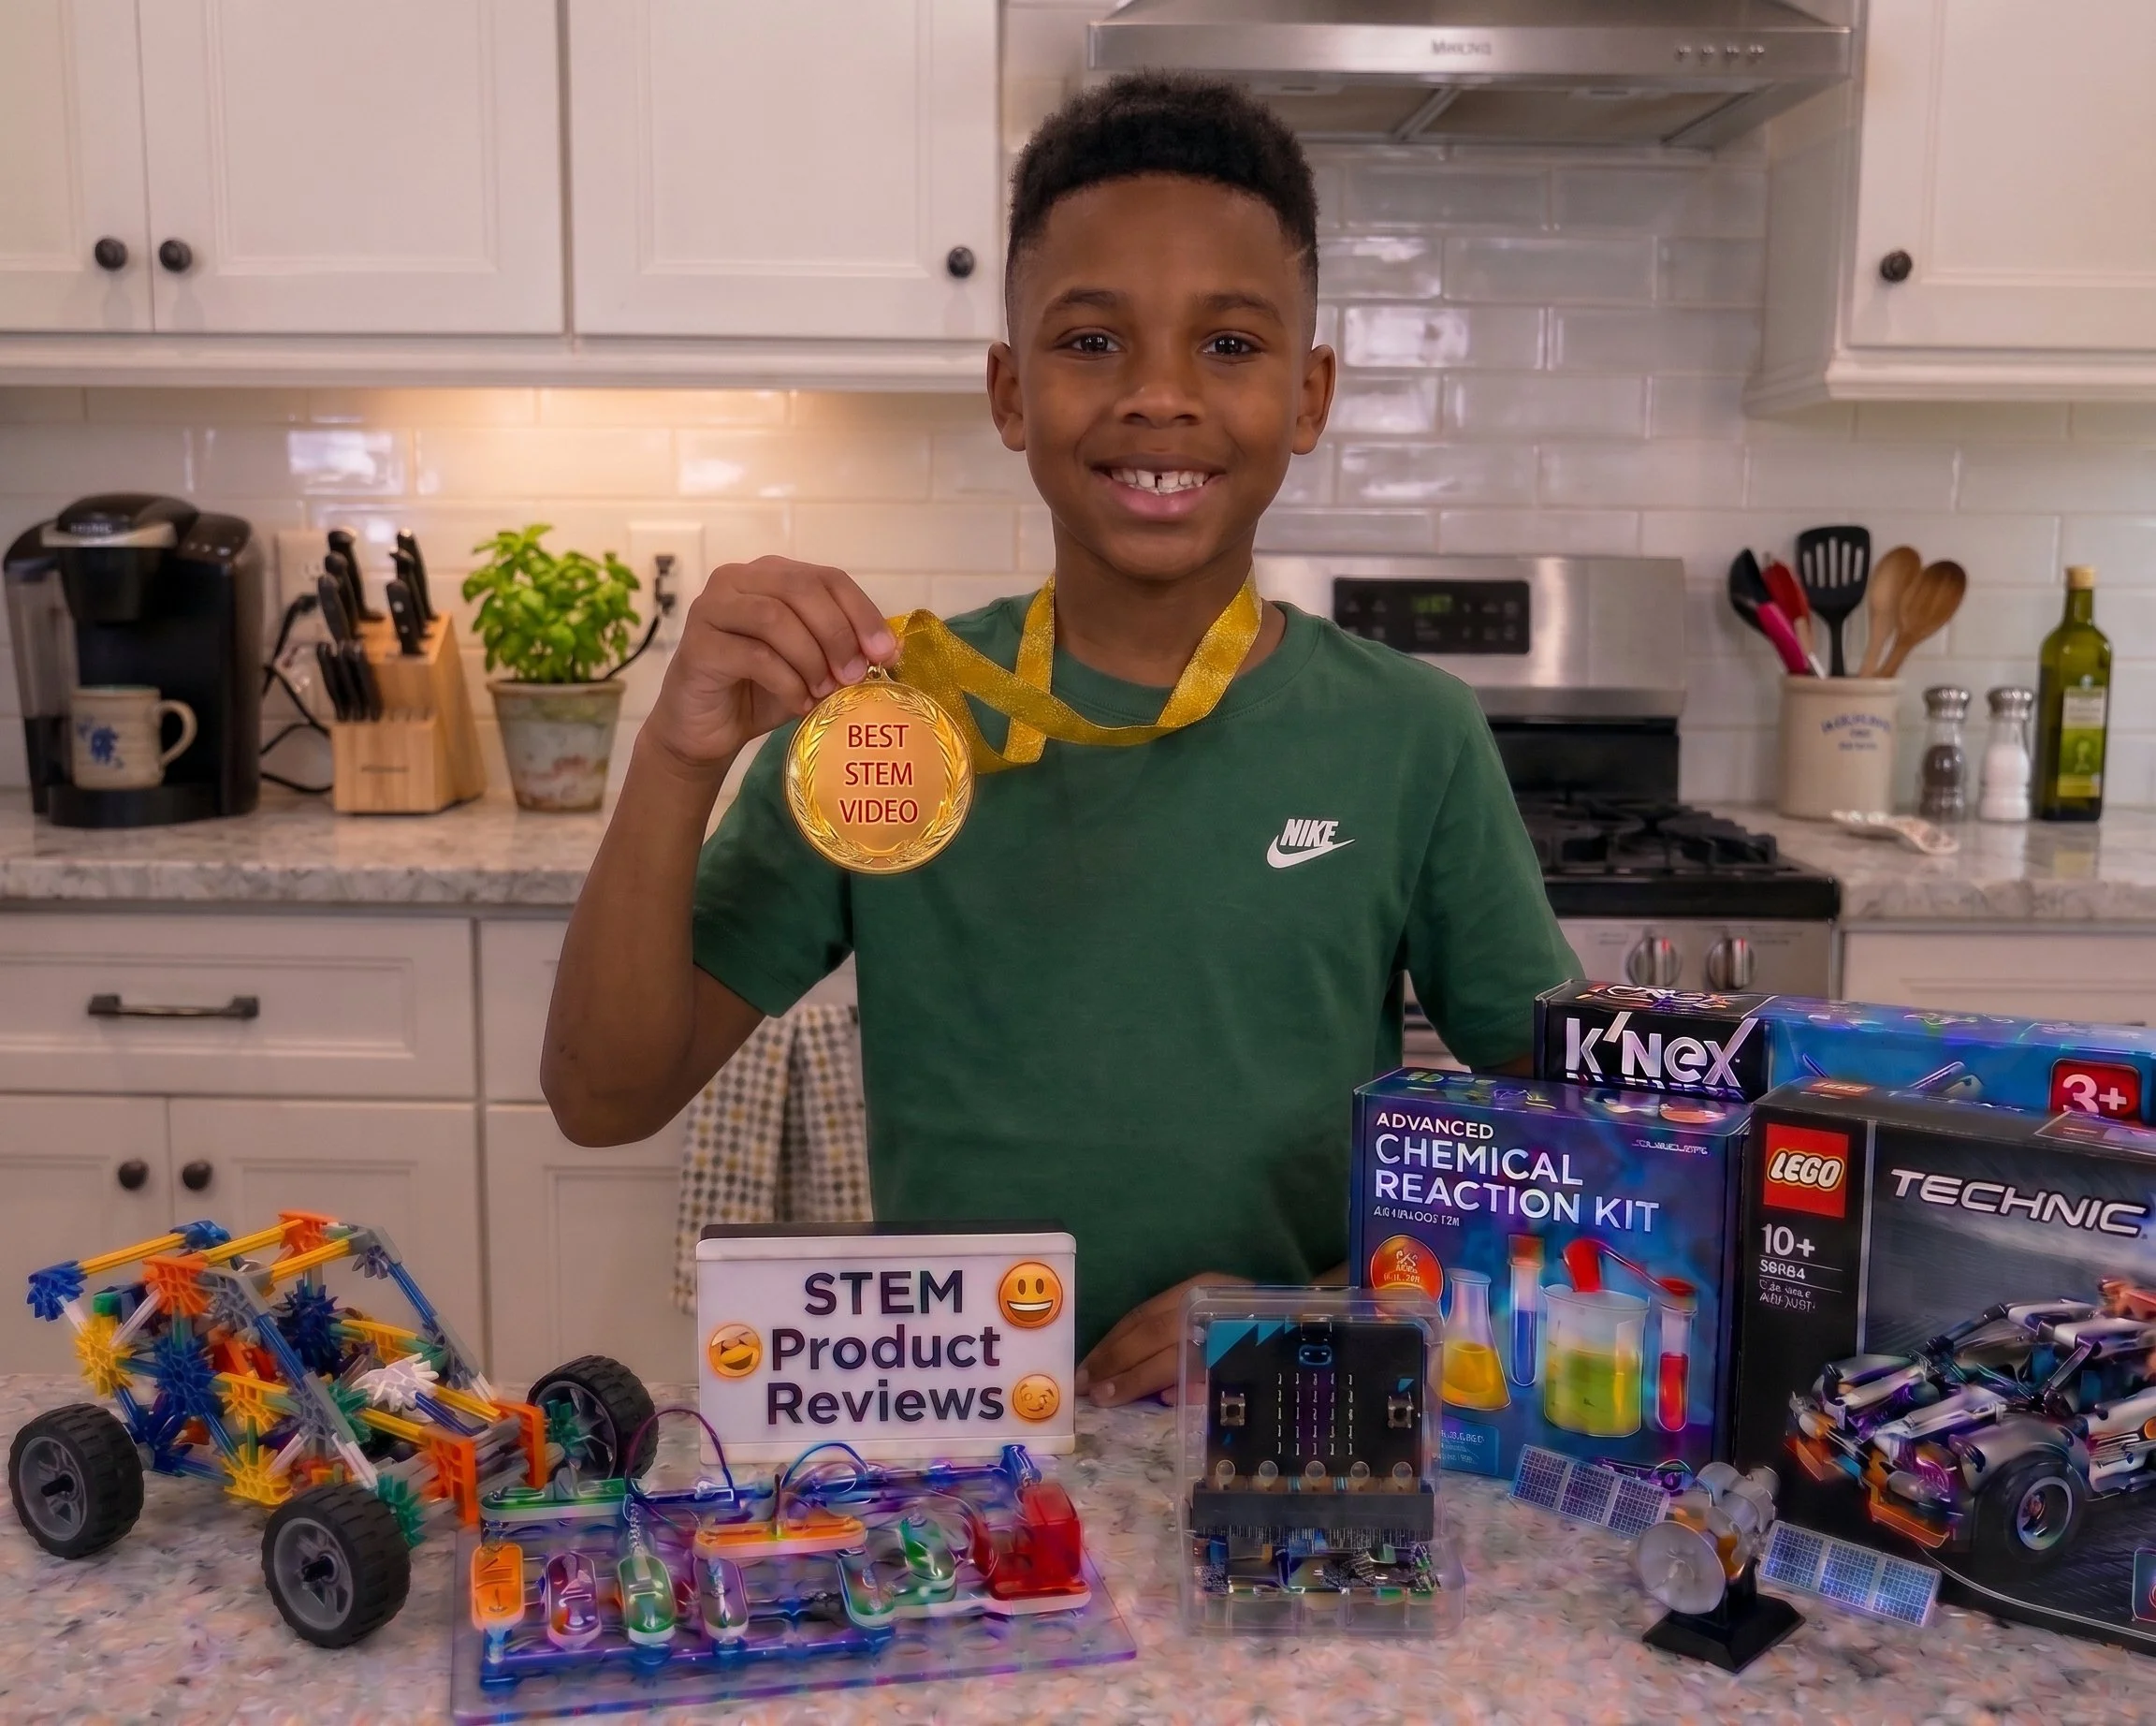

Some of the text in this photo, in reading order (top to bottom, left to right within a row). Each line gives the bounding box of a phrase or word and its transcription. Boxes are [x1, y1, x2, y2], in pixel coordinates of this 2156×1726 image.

[847, 724, 910, 749] BEST
[844, 761, 913, 786] STEM
[838, 799, 919, 824] VIDEO
[1279, 818, 1339, 847] NIKE
[2061, 1074, 2128, 1114] 3+
[1376, 1112, 1494, 1140] ADVANCED
[1374, 1133, 1583, 1187] CHEMICAL
[1770, 1151, 1843, 1189] LEGO
[1374, 1169, 1581, 1226] REACTION
[1595, 1195, 1661, 1234] KIT
[1890, 1168, 2149, 1237] TECHNIC
[1759, 1222, 1815, 1258] 10+
[804, 1269, 965, 1316] STEM
[772, 1324, 1002, 1371] Product
[766, 1378, 1006, 1426] Reviews
